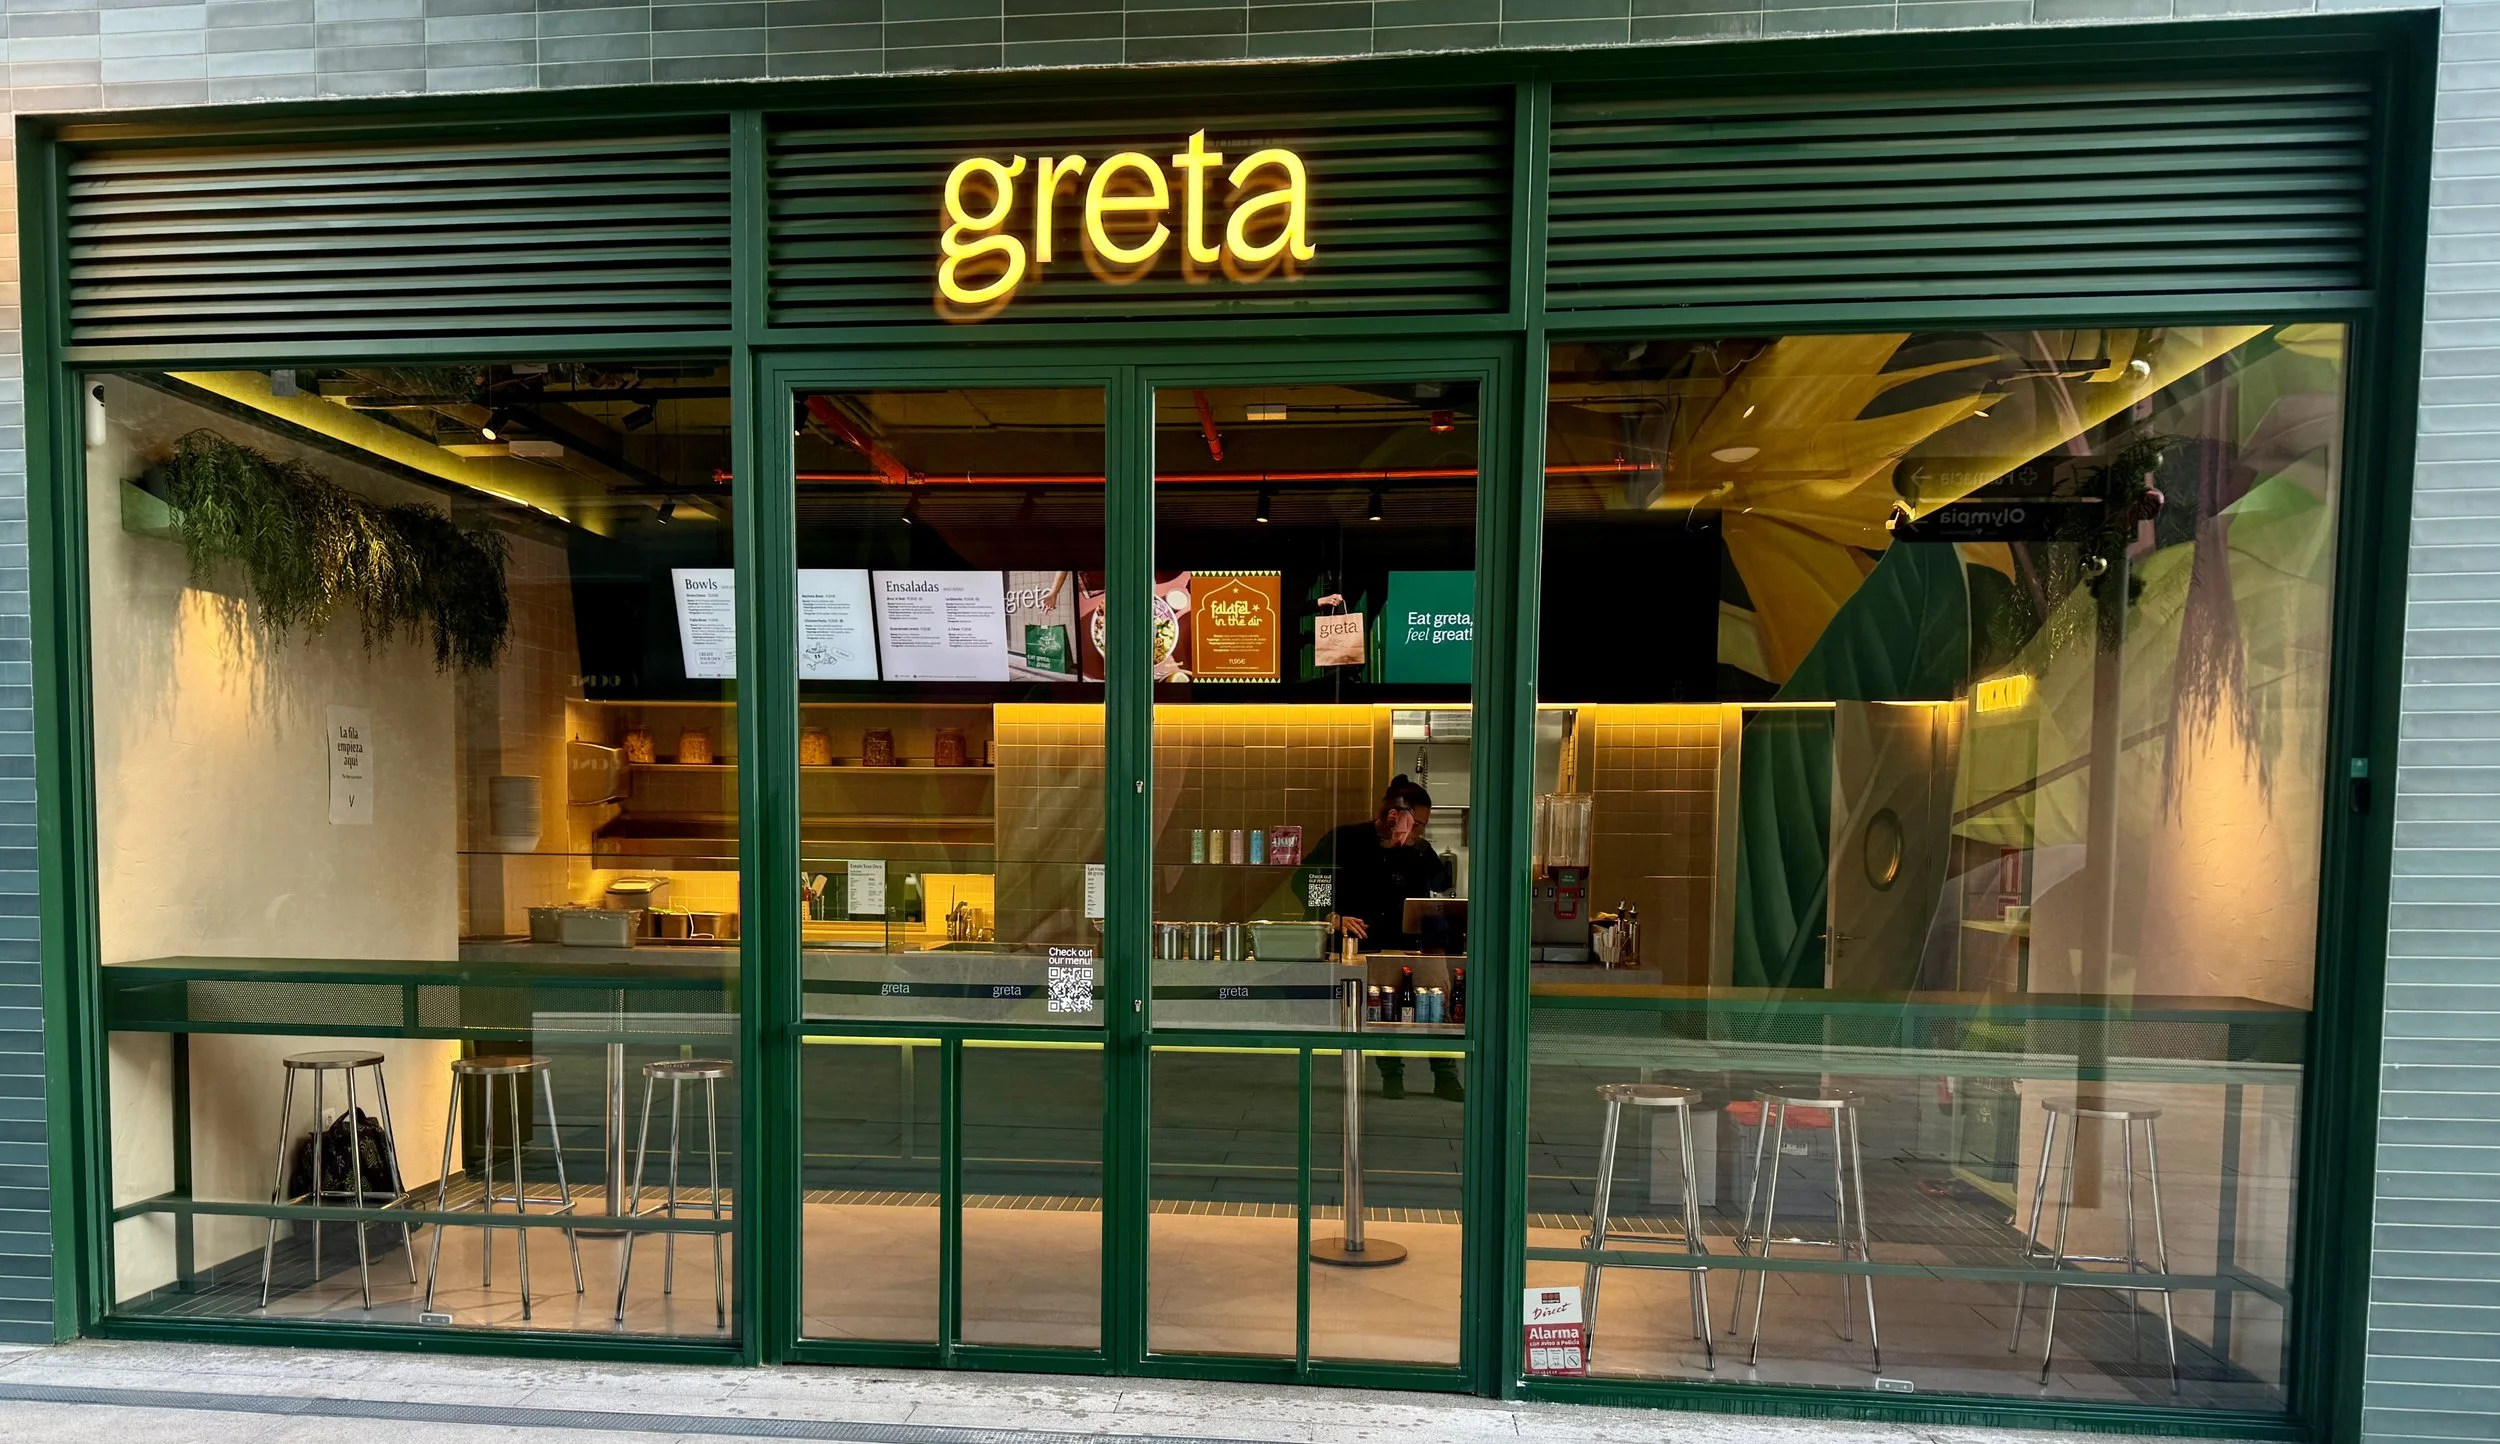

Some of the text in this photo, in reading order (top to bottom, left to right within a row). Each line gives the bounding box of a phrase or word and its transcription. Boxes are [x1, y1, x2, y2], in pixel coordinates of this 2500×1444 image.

[938, 128, 1316, 304] greta
[685, 578, 718, 590] Bowls
[886, 580, 939, 592] Ensaladas
[1215, 616, 1226, 626] in
[1248, 616, 1262, 626] air
[1408, 612, 1473, 627] Eat greta,
[1320, 621, 1358, 638] greta
[1405, 628, 1473, 645] feel great!
[340, 726, 359, 739] La fila
[338, 741, 363, 755] empieza
[344, 755, 358, 769] aquí
[1049, 947, 1093, 957] Check out
[1049, 957, 1064, 965] our
[881, 983, 910, 996] greta
[993, 985, 1022, 998] greta
[1219, 985, 1249, 999] greta
[1532, 1302, 1572, 1320] Direct
[1530, 1326, 1579, 1339] Alarma
